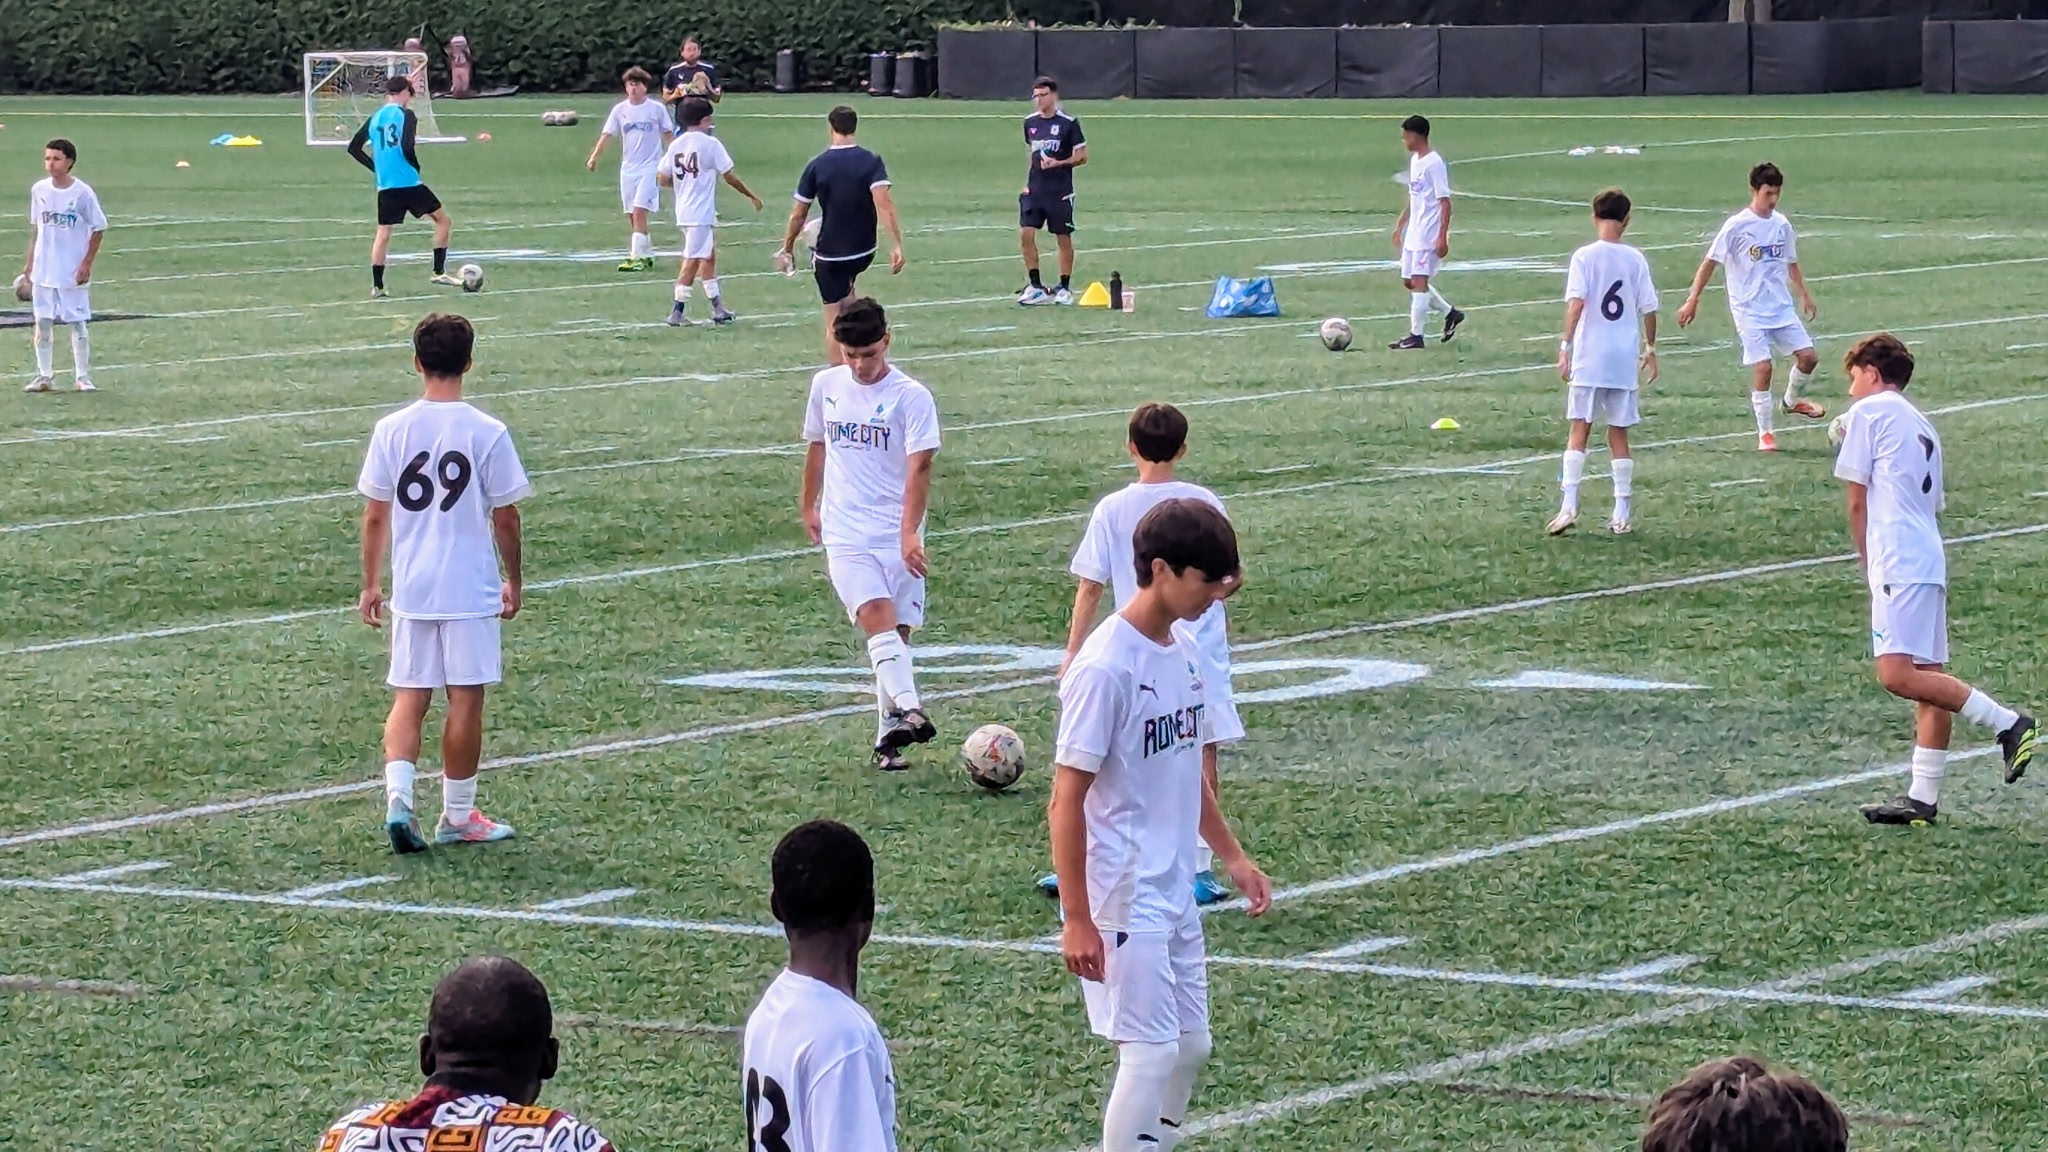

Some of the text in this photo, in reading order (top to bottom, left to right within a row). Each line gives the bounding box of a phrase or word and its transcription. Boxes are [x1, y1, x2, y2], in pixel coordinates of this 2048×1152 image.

[377, 123, 399, 150] 13
[674, 151, 699, 180] 54
[1601, 279, 1624, 321] 6
[396, 450, 472, 513] 69
